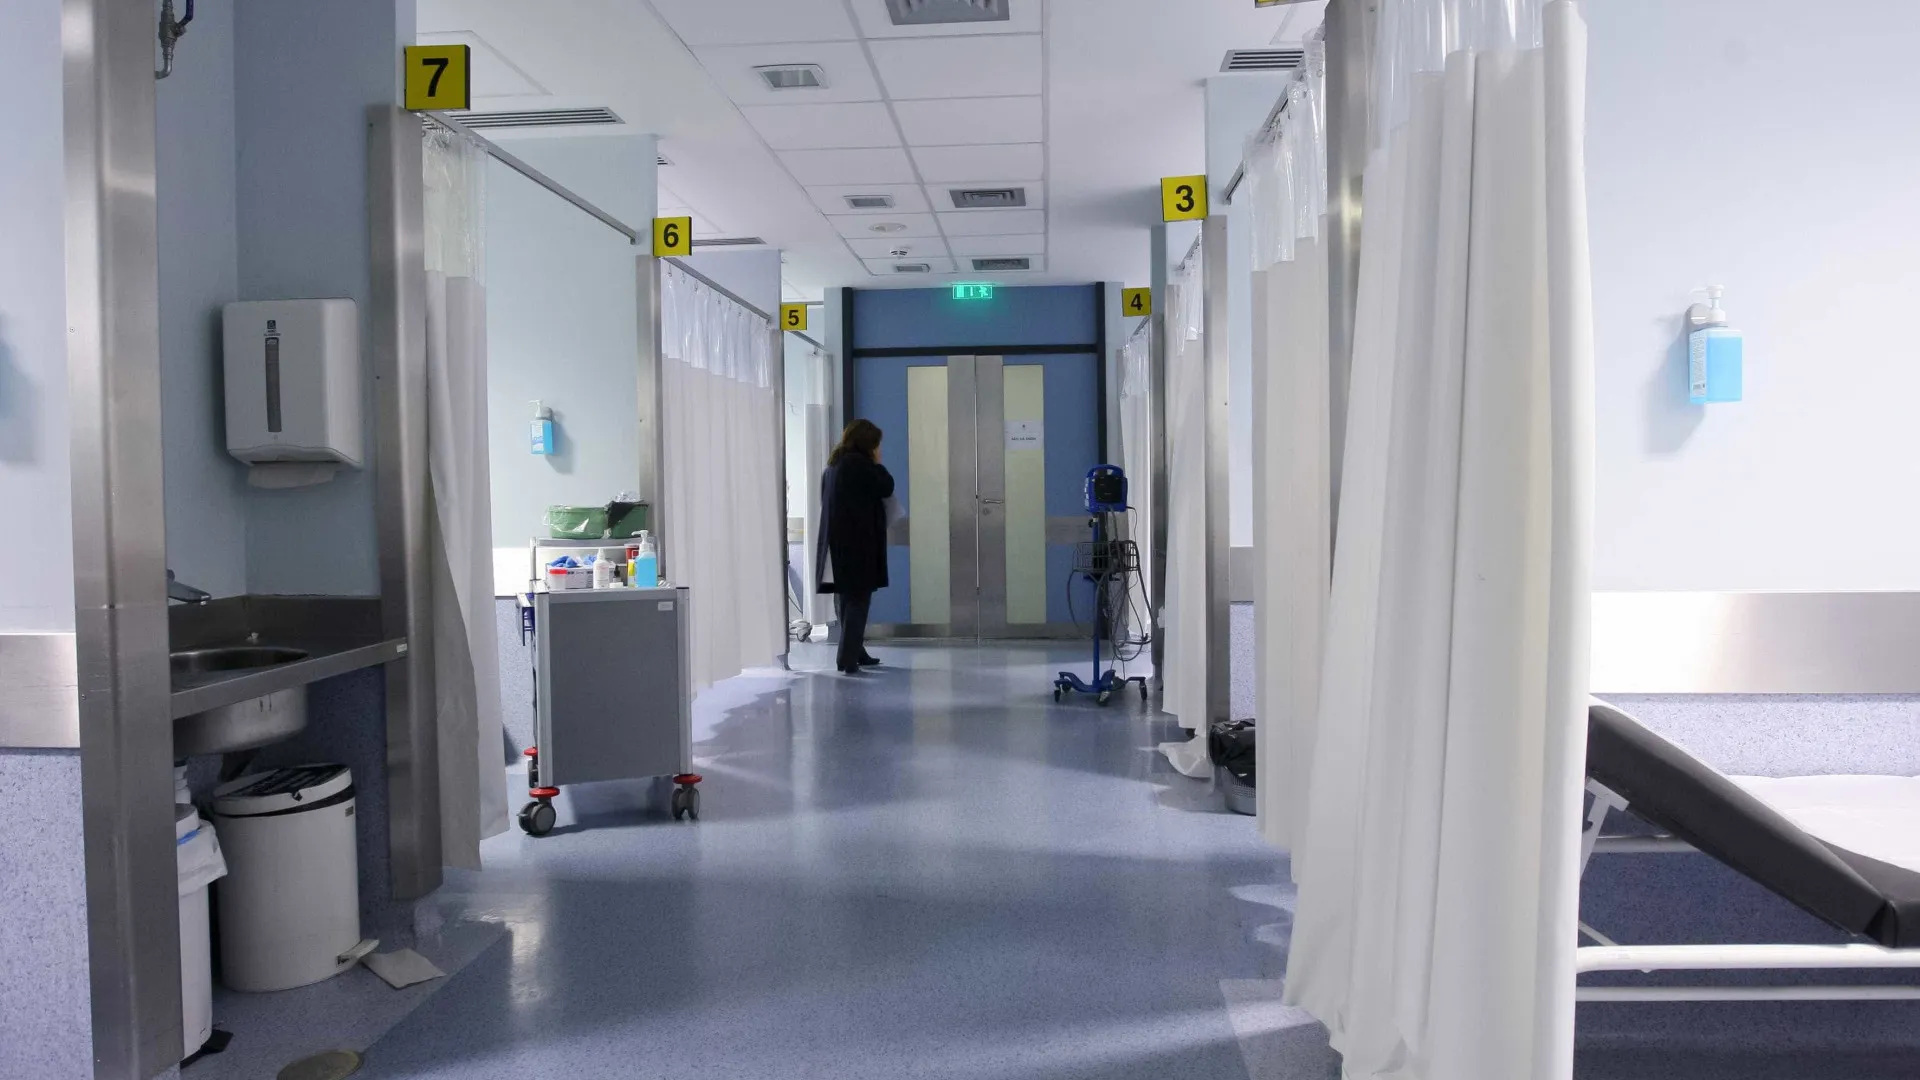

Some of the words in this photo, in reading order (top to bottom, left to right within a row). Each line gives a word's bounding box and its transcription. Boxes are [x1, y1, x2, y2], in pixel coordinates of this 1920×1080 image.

[421, 57, 450, 98] 7
[1175, 184, 1195, 213] 3
[663, 223, 679, 248] 6
[1130, 292, 1144, 312] 4
[788, 309, 800, 327] 5
